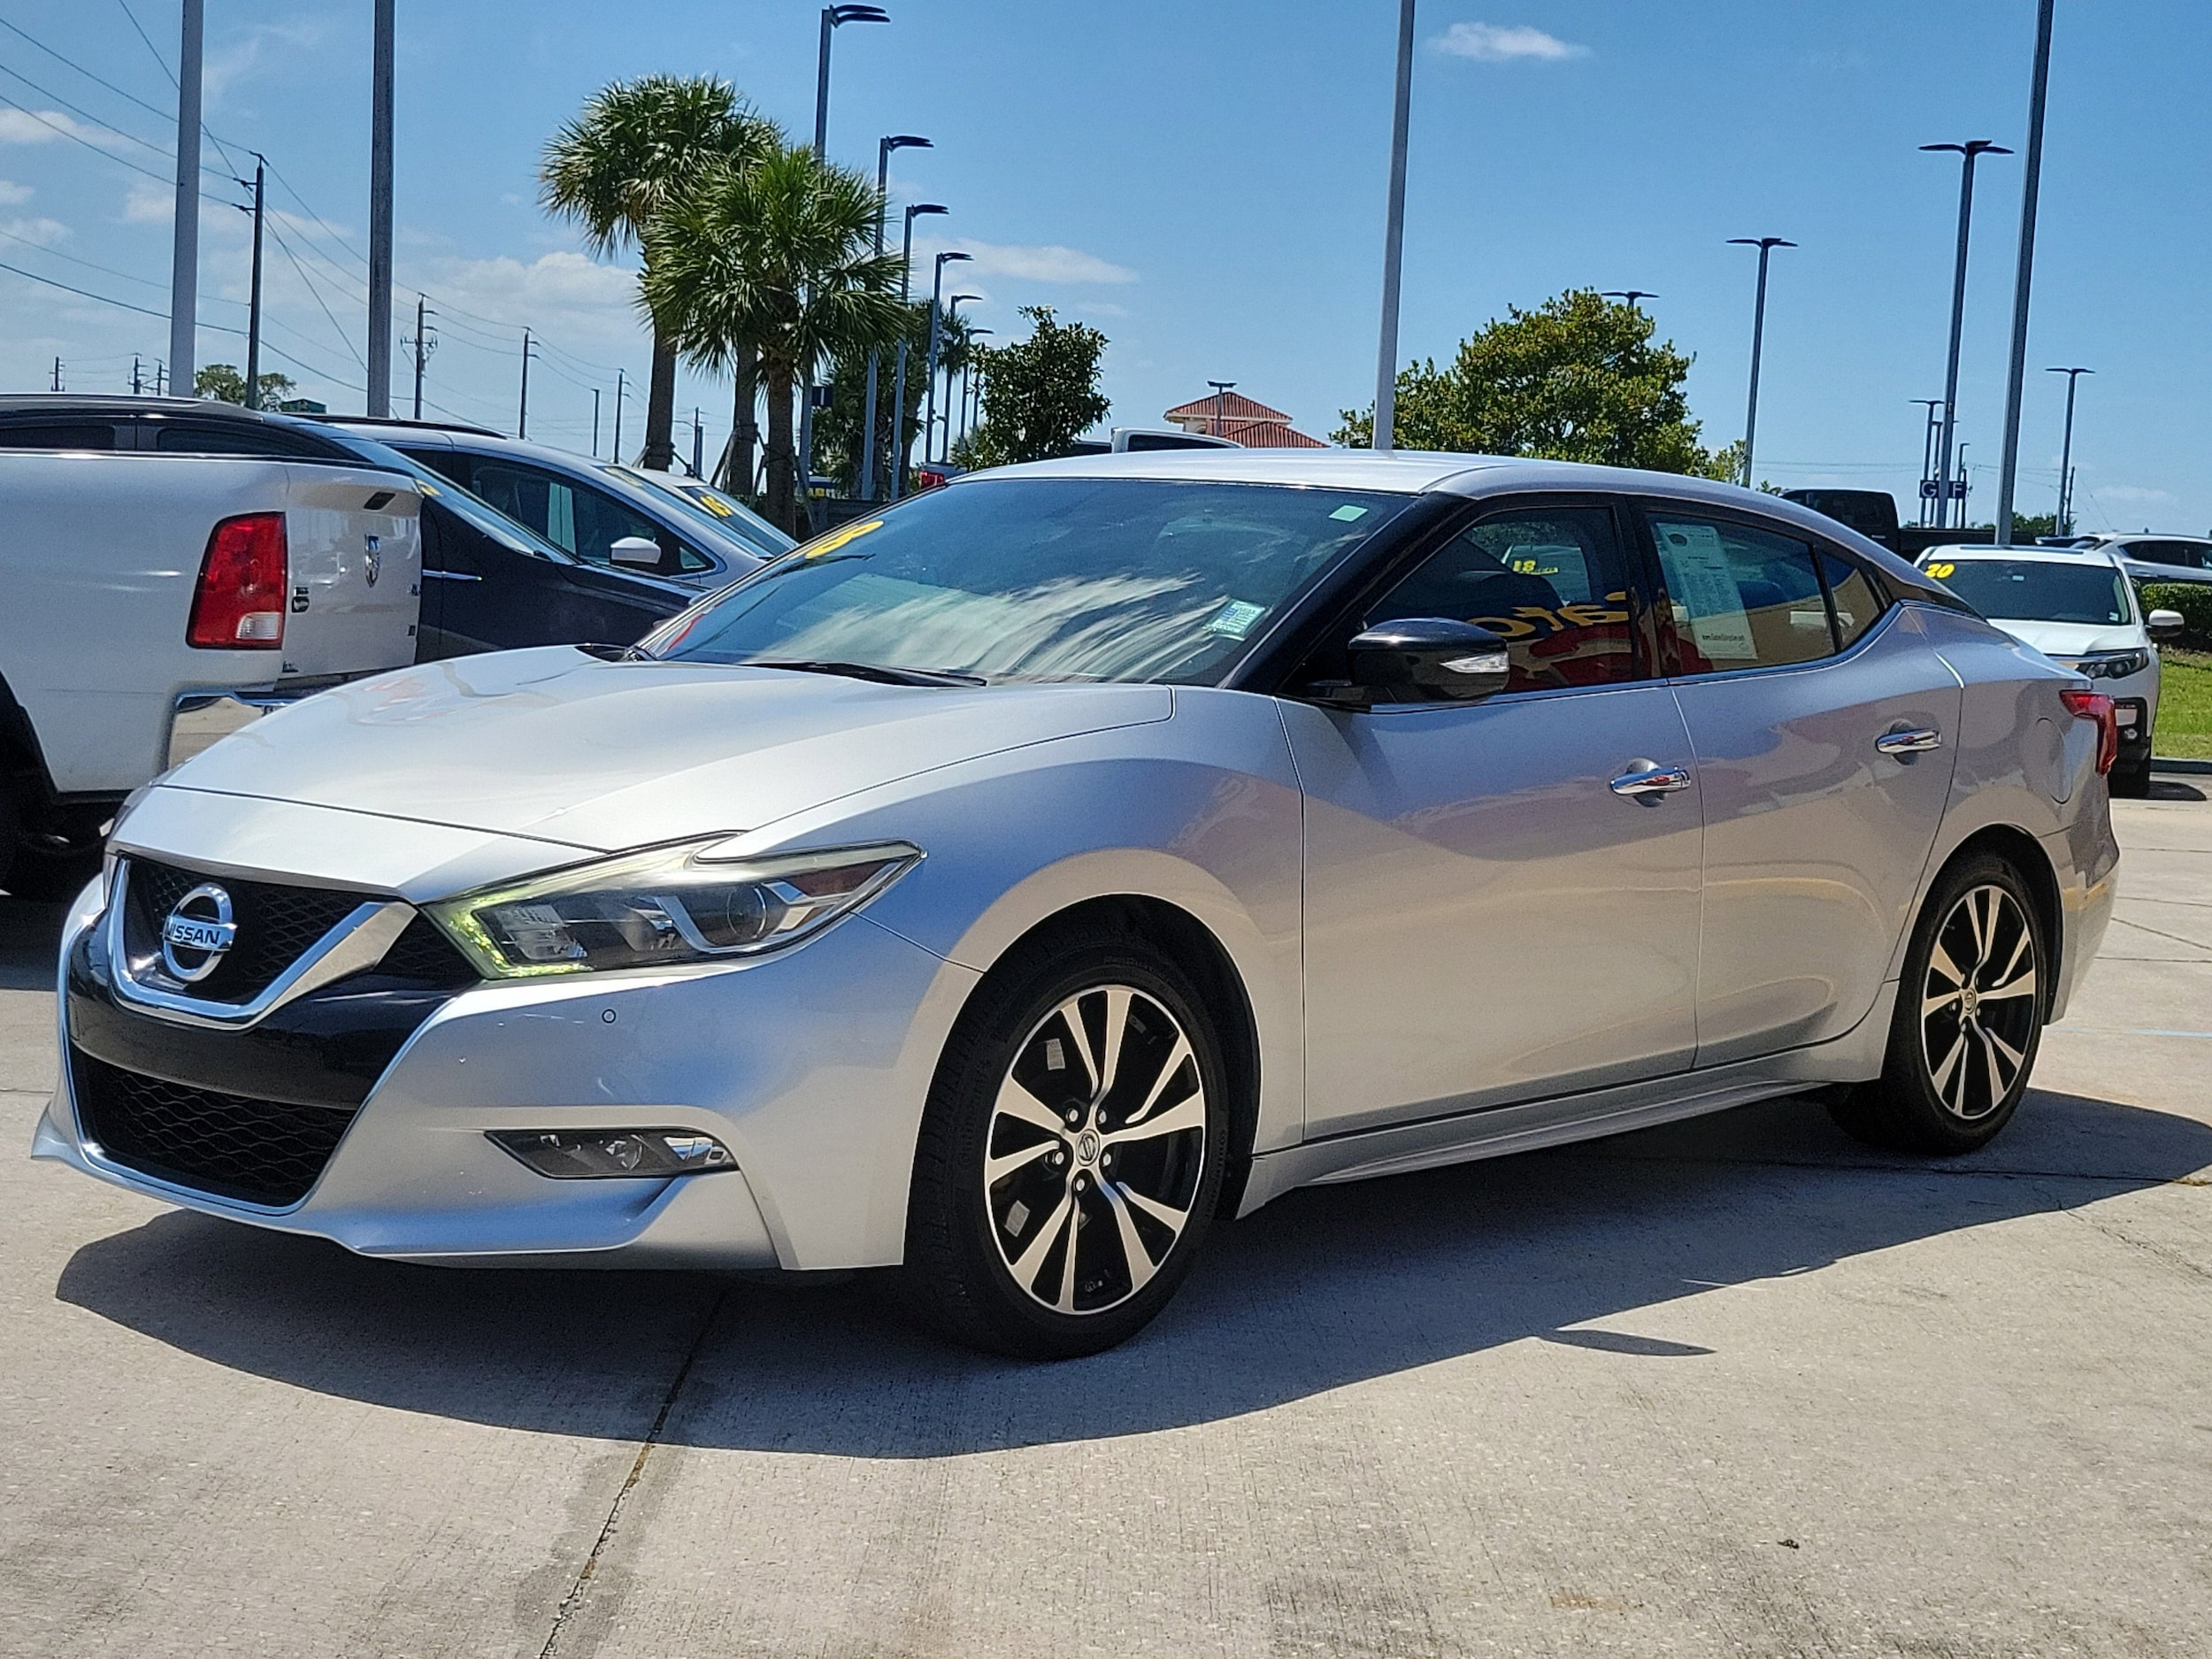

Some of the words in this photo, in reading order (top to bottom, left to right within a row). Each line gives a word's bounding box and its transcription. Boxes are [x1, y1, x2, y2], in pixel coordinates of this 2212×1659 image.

[1921, 481, 1938, 497] G
[1952, 482, 1962, 497] F
[1924, 563, 1955, 578] 20
[165, 921, 220, 945] NISSAN
